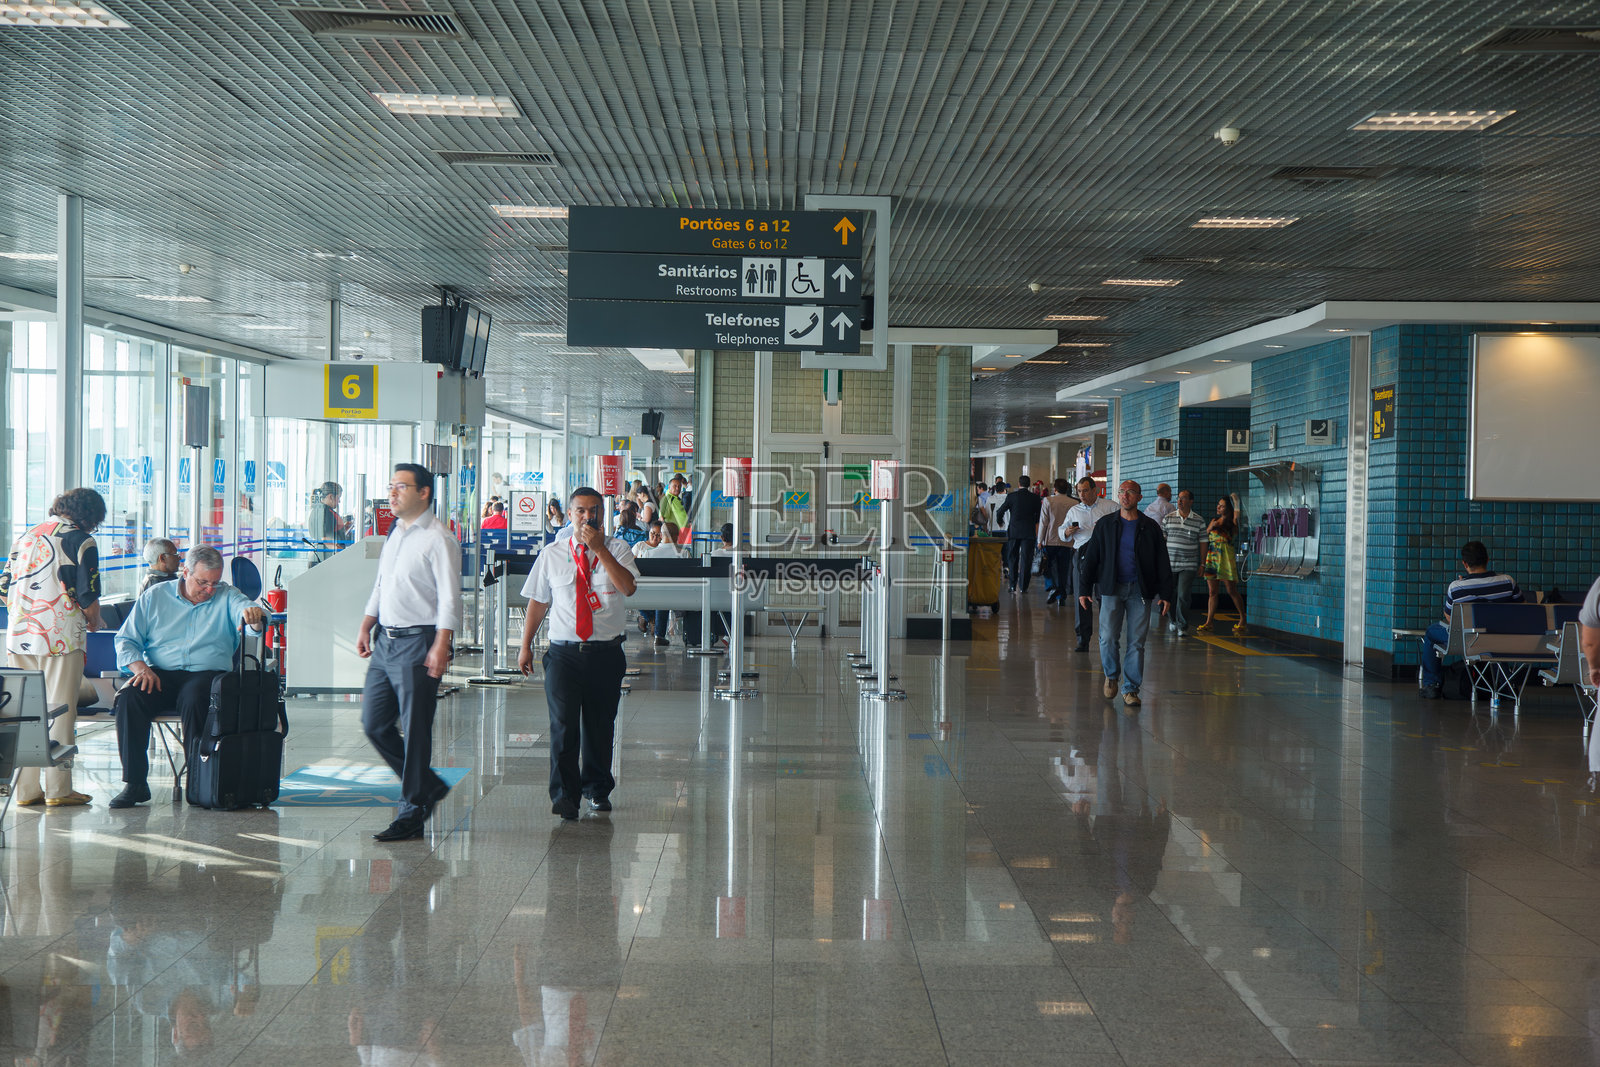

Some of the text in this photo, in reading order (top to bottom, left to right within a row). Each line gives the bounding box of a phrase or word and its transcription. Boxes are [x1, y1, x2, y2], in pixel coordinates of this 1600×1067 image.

[679, 217, 790, 233] Portões 6 a 12
[711, 238, 788, 250] Gates 6 to 12
[658, 263, 738, 279] Sanitários
[676, 284, 737, 297] Restrooms
[705, 312, 780, 328] Telefones
[715, 333, 780, 347] Telephones
[341, 374, 361, 400] 6
[617, 439, 625, 450] 7
